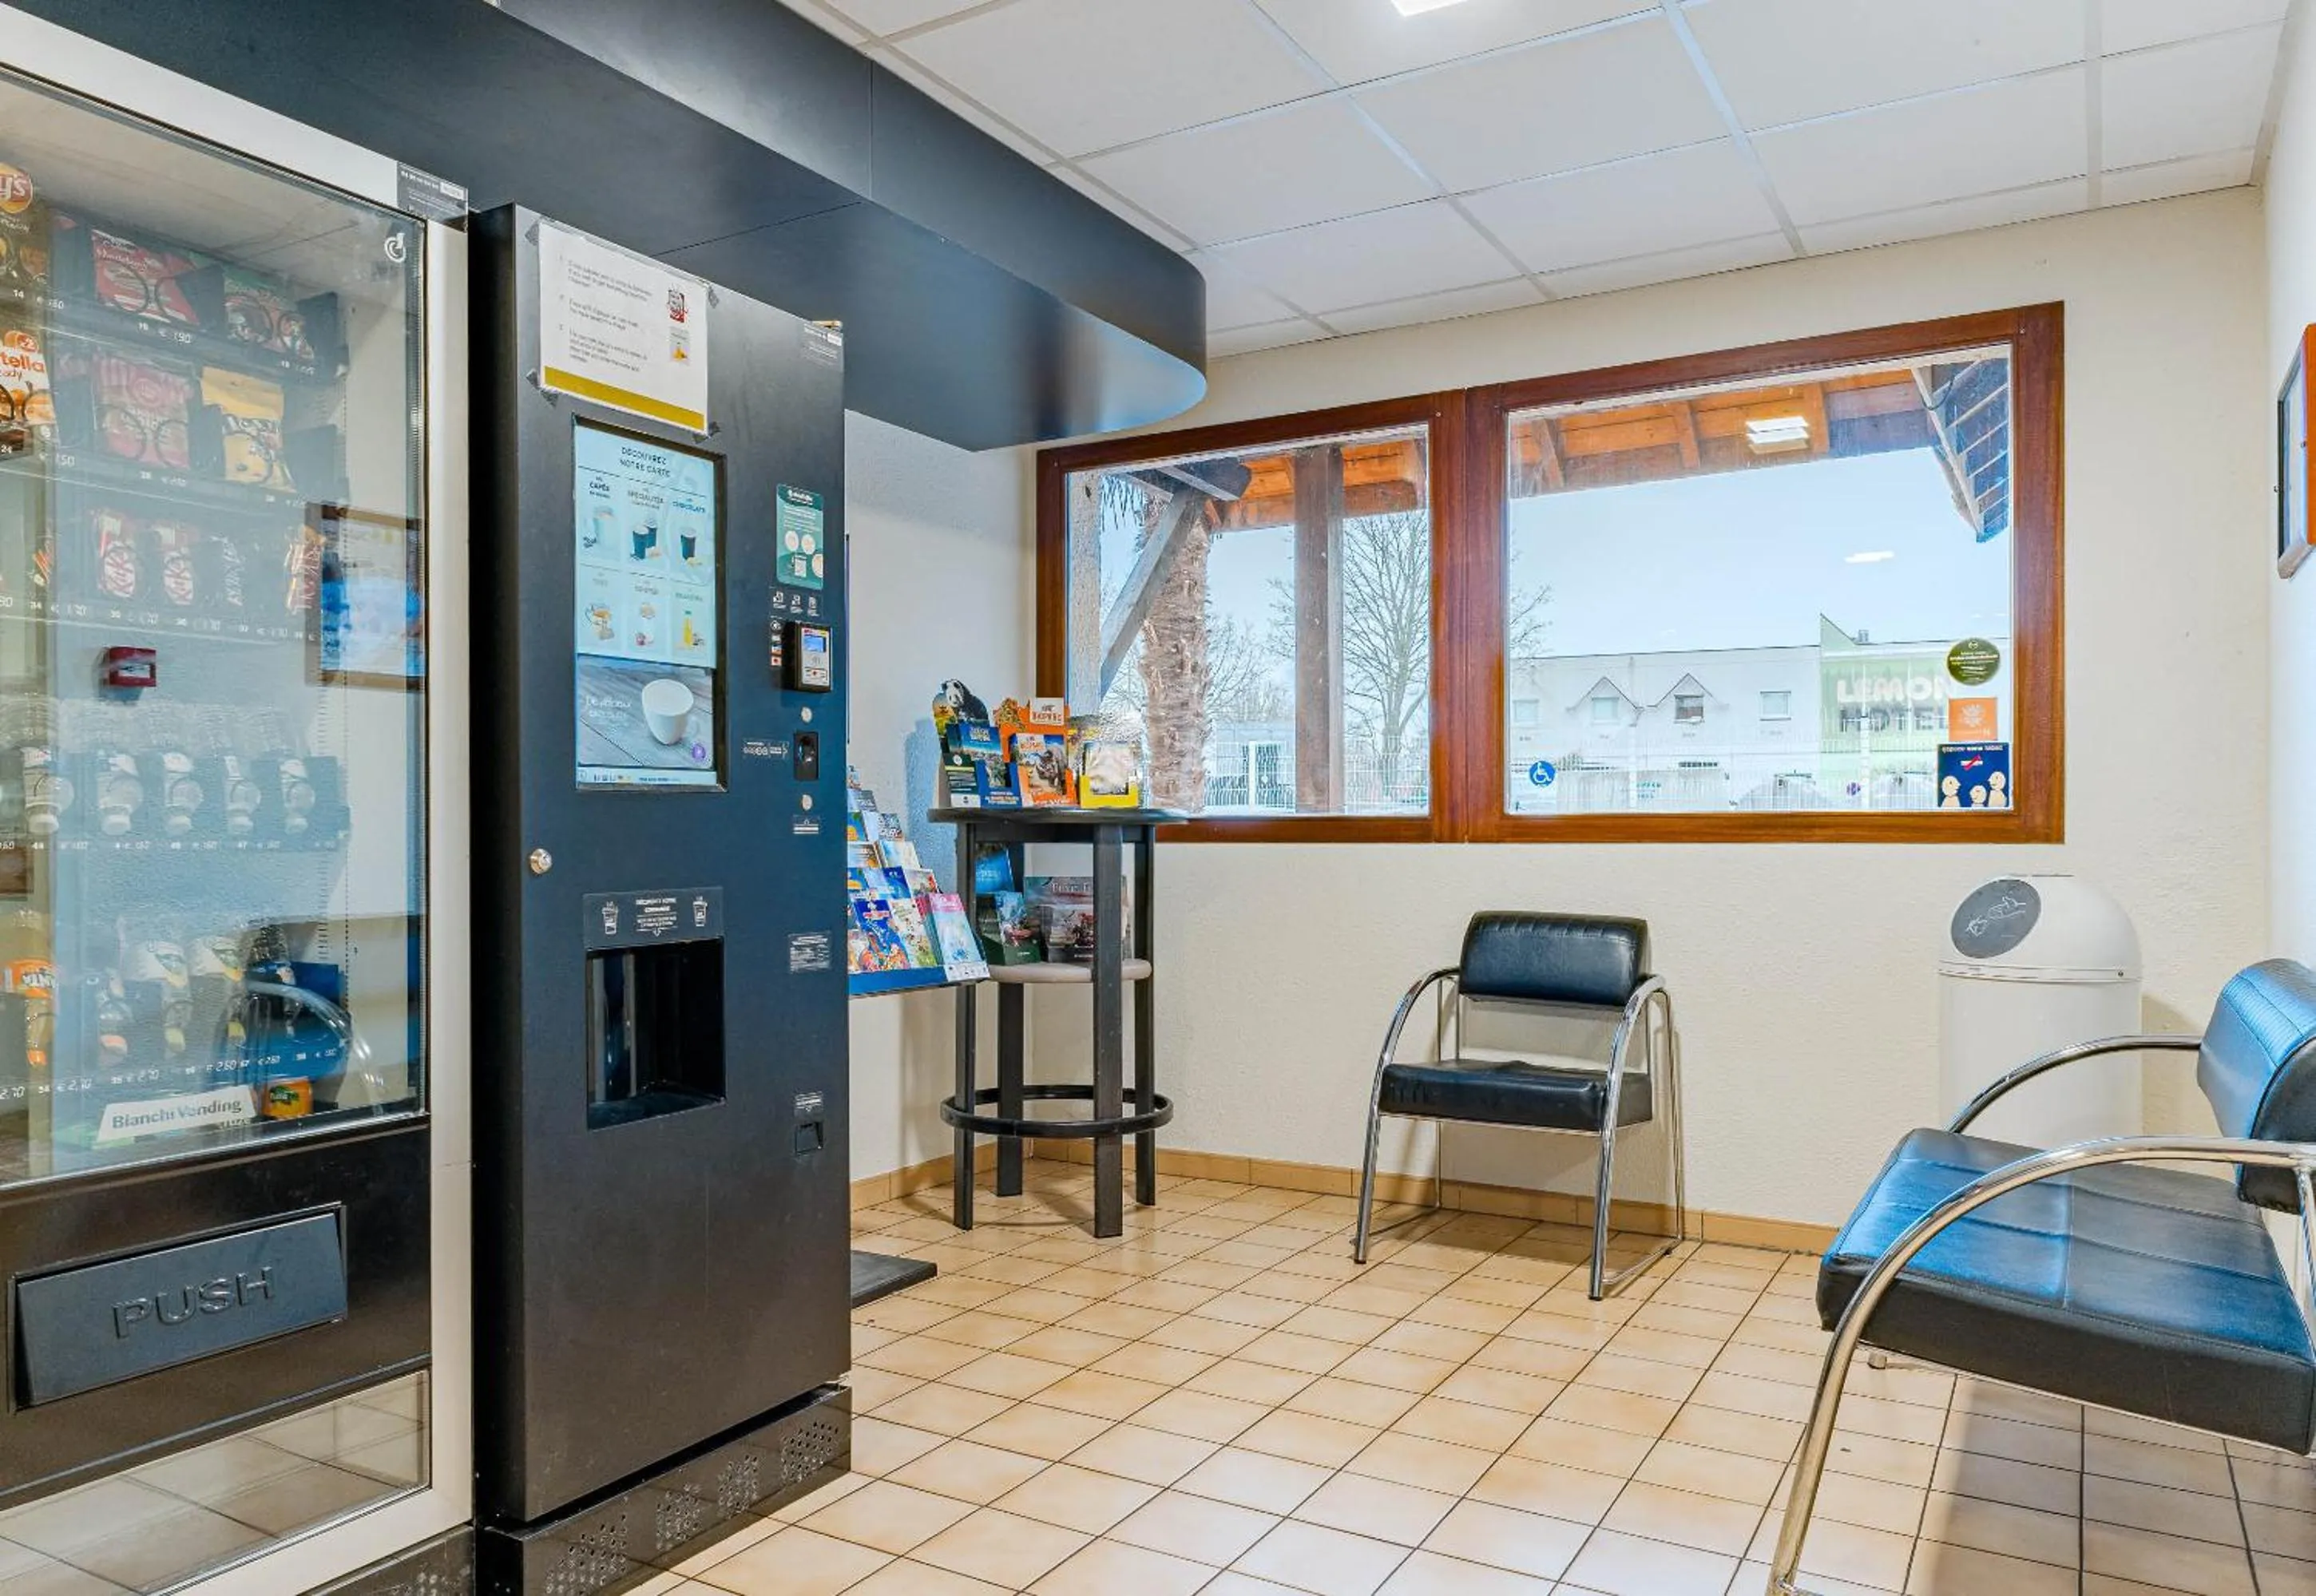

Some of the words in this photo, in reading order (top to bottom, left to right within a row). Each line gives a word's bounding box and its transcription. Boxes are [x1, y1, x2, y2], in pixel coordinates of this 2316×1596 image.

[112, 1110, 174, 1129] Bianchi
[175, 1099, 242, 1121] Vending
[111, 1266, 276, 1340] PUSH
